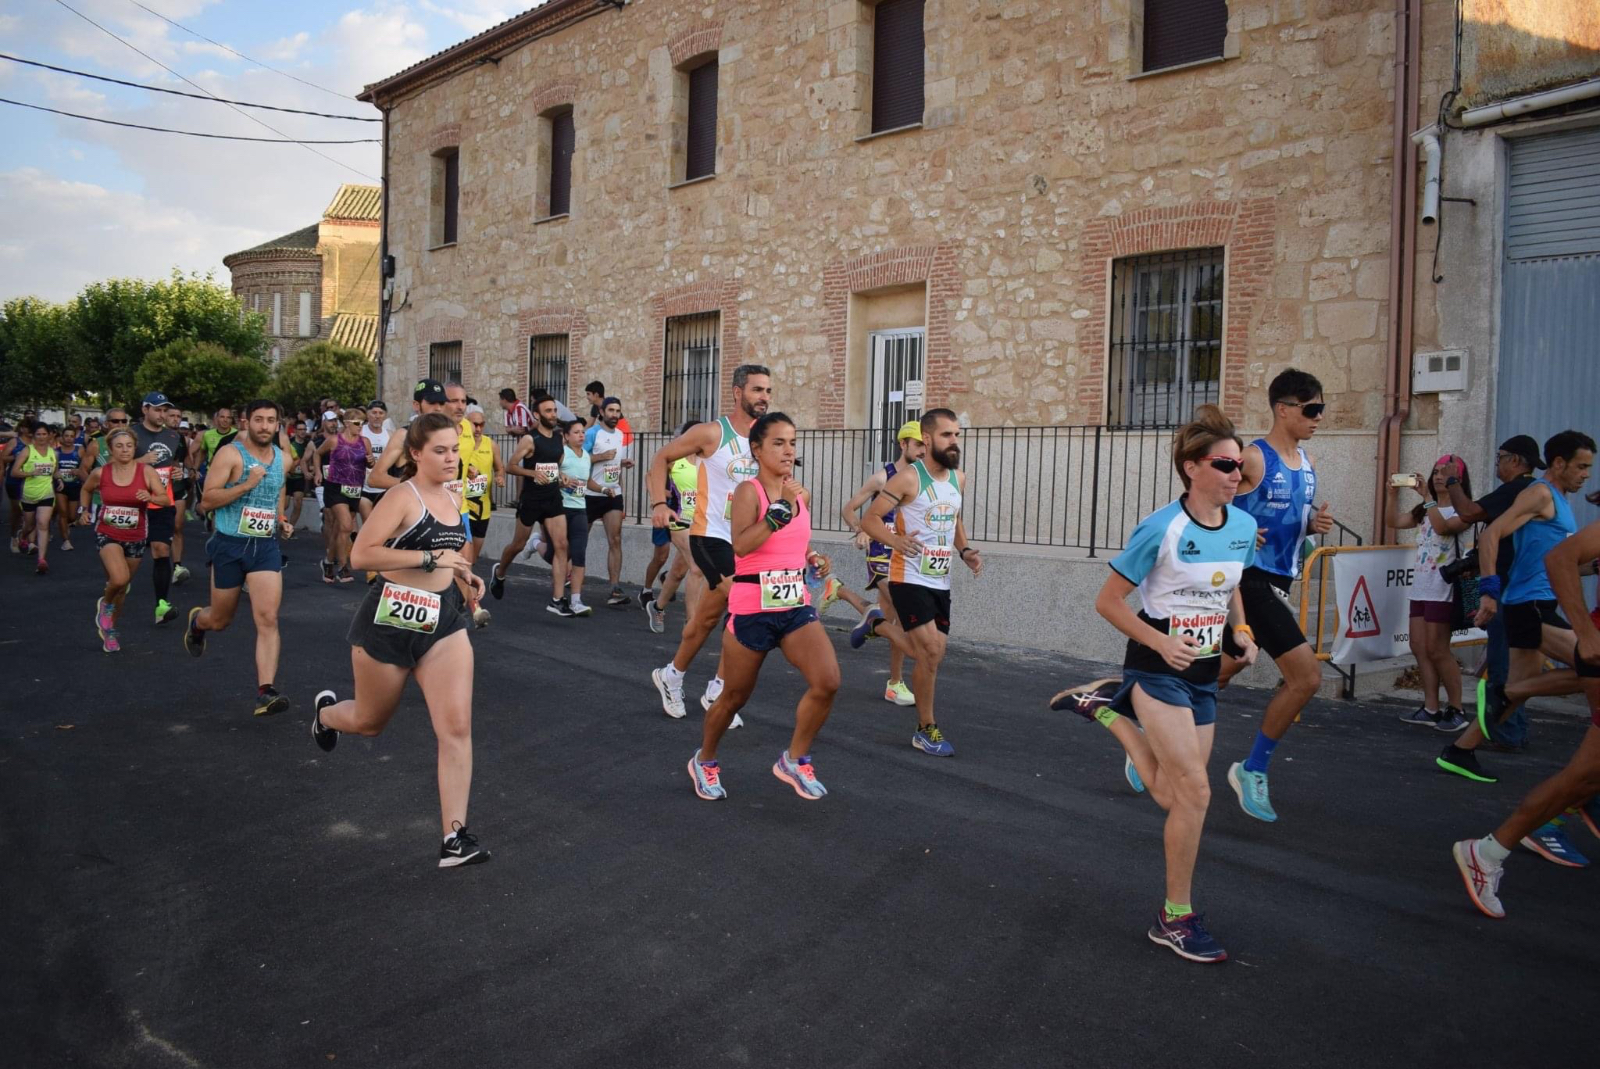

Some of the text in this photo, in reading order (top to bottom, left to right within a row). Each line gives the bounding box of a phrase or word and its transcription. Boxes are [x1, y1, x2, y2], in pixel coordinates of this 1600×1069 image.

[111, 515, 132, 525] 254
[248, 518, 270, 531] 266
[1386, 568, 1415, 587] PRE
[383, 586, 440, 610] bedunia
[771, 583, 798, 600] 271
[389, 601, 428, 623] 200
[1171, 612, 1226, 629] bedunia
